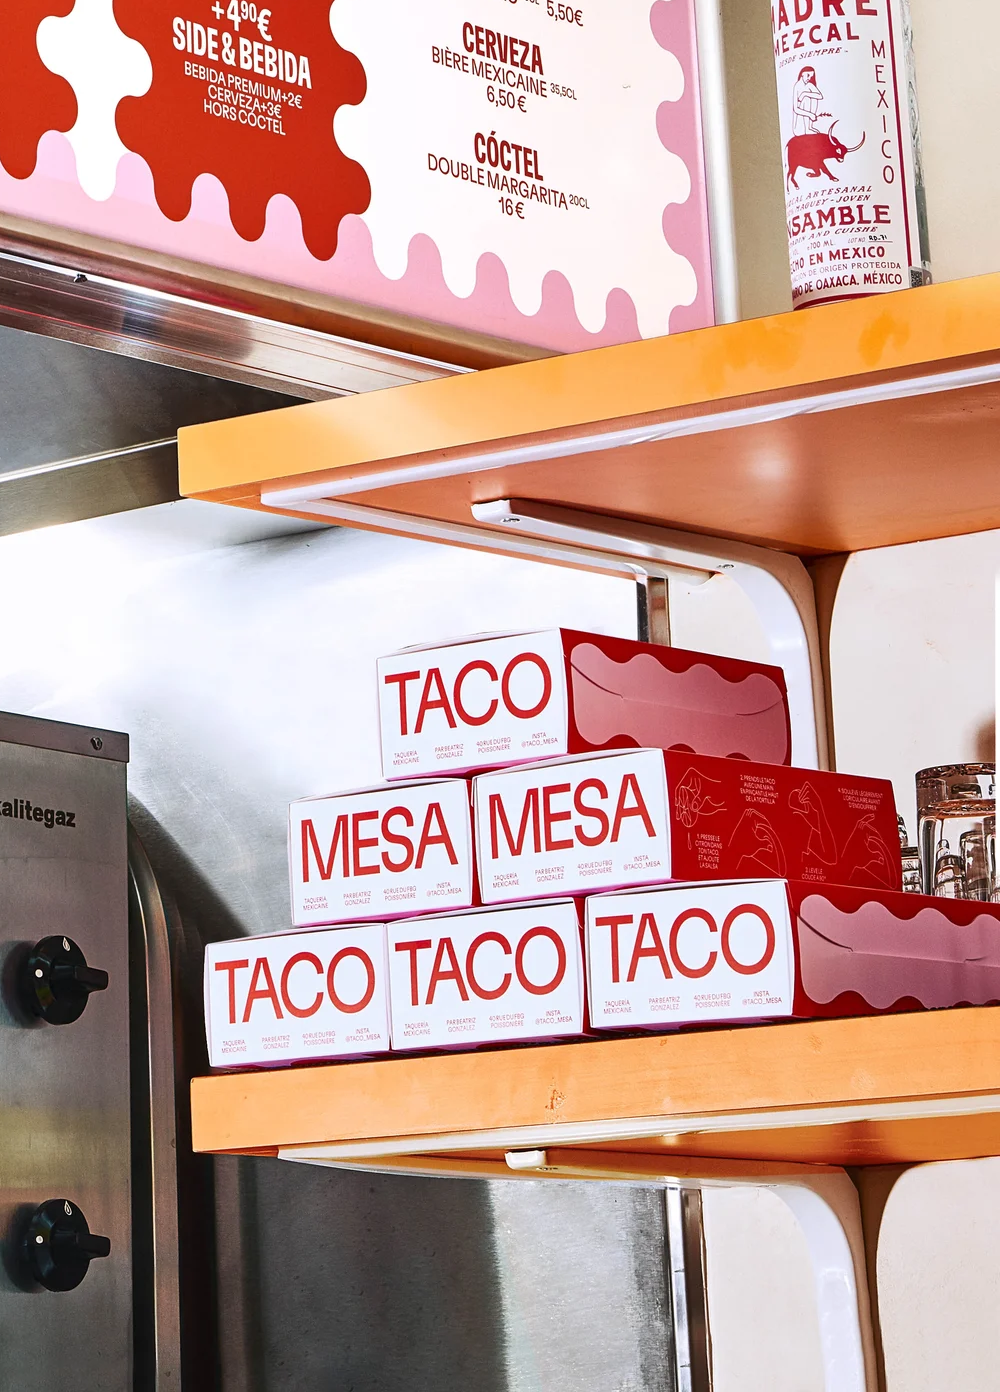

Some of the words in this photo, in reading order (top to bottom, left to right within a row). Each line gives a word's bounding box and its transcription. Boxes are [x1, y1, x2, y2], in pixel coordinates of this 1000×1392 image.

[173, 16, 218, 61] SIDE
[222, 32, 236, 66] &
[239, 37, 312, 89] BEBIDA
[432, 46, 469, 74] BIÈRE
[472, 58, 547, 98] MEXICAINE
[463, 22, 543, 75] CERVEZA
[204, 99, 236, 121] HORS
[238, 108, 286, 136] CÓCTEL
[428, 153, 484, 186] DOUBLE
[487, 171, 568, 210] MARGARITA
[474, 131, 543, 181] CÓCTEL
[806, 186, 872, 200] ARTESANAL
[809, 231, 830, 240] AND
[810, 252, 823, 266] EN
[829, 246, 885, 261] MEXICO
[805, 281, 813, 293] DE
[864, 271, 902, 284] MÉXICO
[820, 264, 847, 273] ORIGEN
[384, 652, 552, 737] TACO
[393, 757, 419, 765] MEXICAINE
[521, 738, 558, 748] @TACO_MESA
[489, 773, 657, 860] MESA
[301, 803, 458, 883] MESA
[624, 861, 660, 871] @TACO_MESA
[395, 926, 567, 1006] TACO
[596, 902, 776, 984] TACO
[215, 946, 376, 1024] TACO
